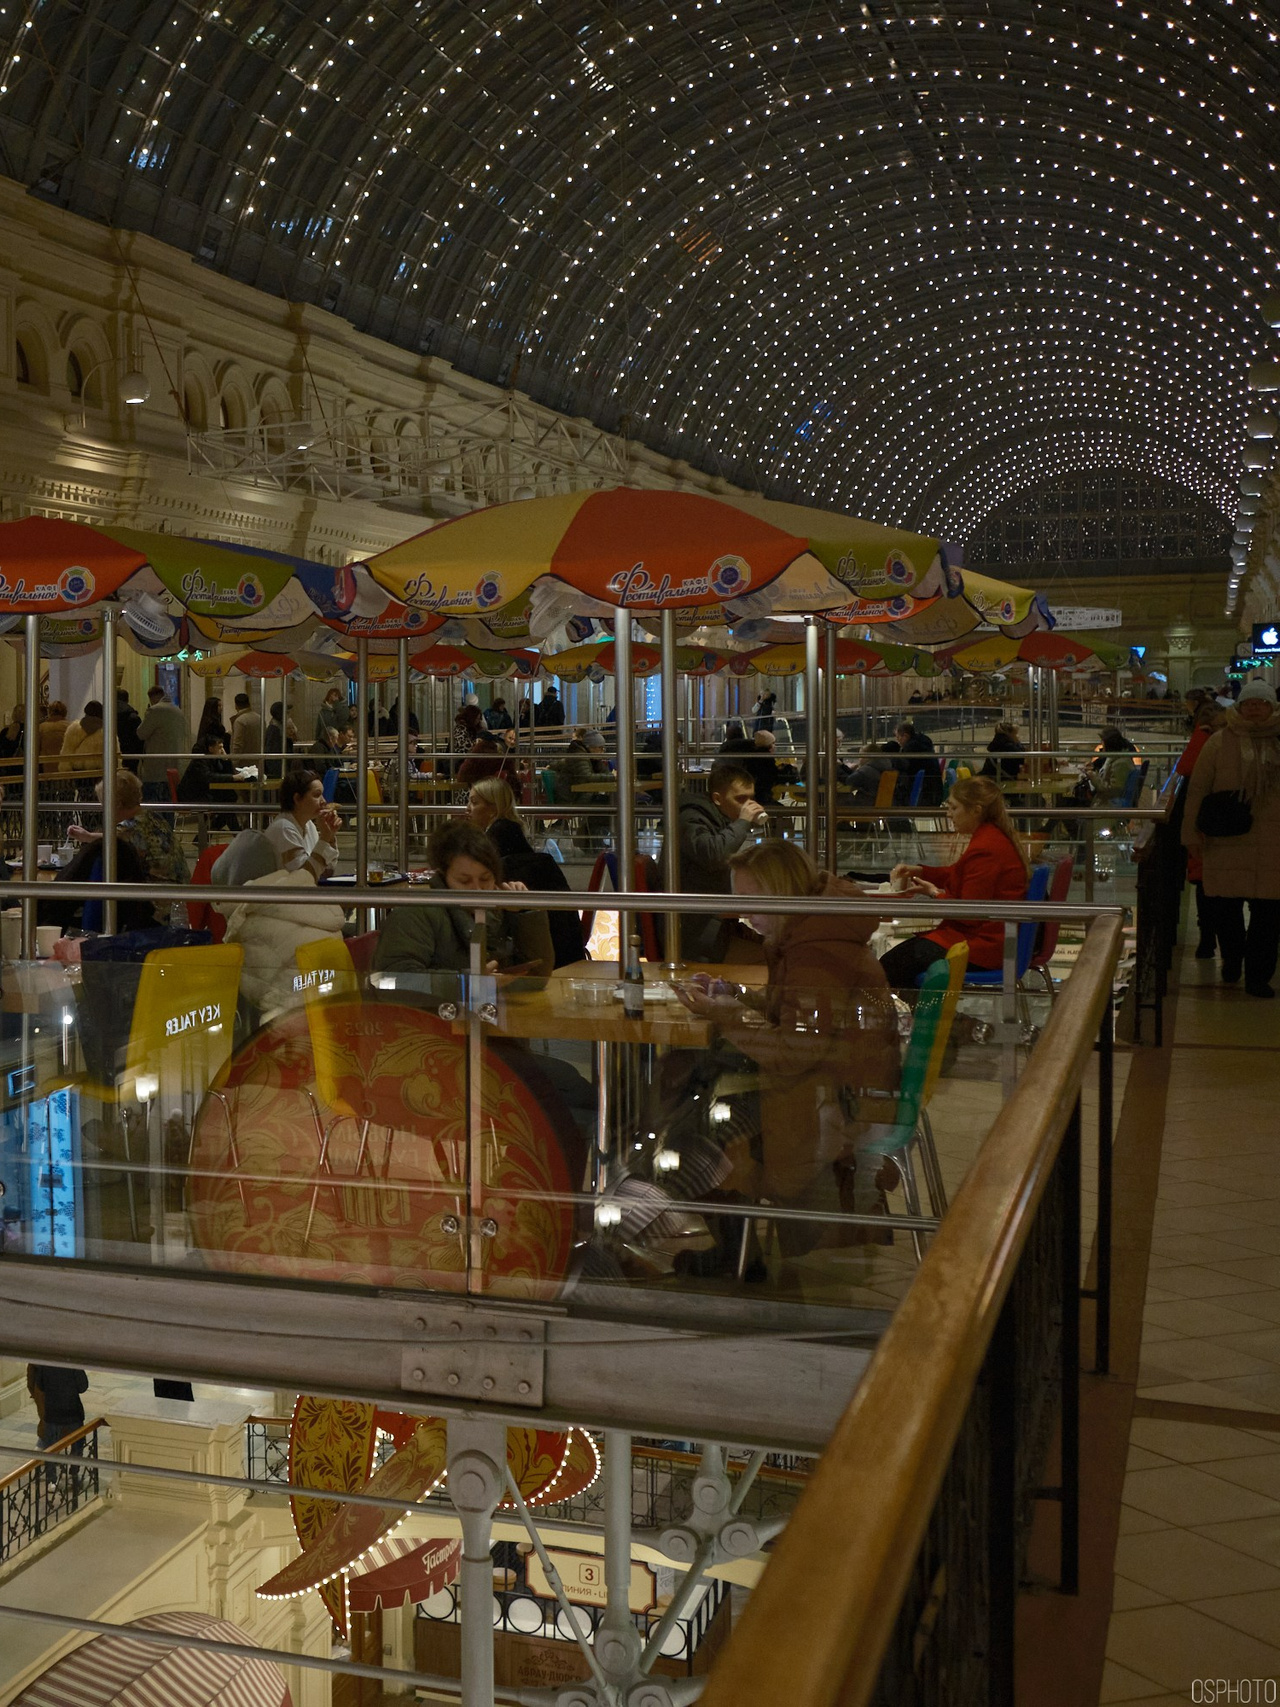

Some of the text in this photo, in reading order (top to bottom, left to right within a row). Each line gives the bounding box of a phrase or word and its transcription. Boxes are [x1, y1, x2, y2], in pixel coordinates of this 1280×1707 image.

[611, 562, 708, 606] Фестивальное
[682, 578, 708, 587] КАФЕ
[35, 584, 58, 592] КАФЕ
[585, 1569, 595, 1581] 3
